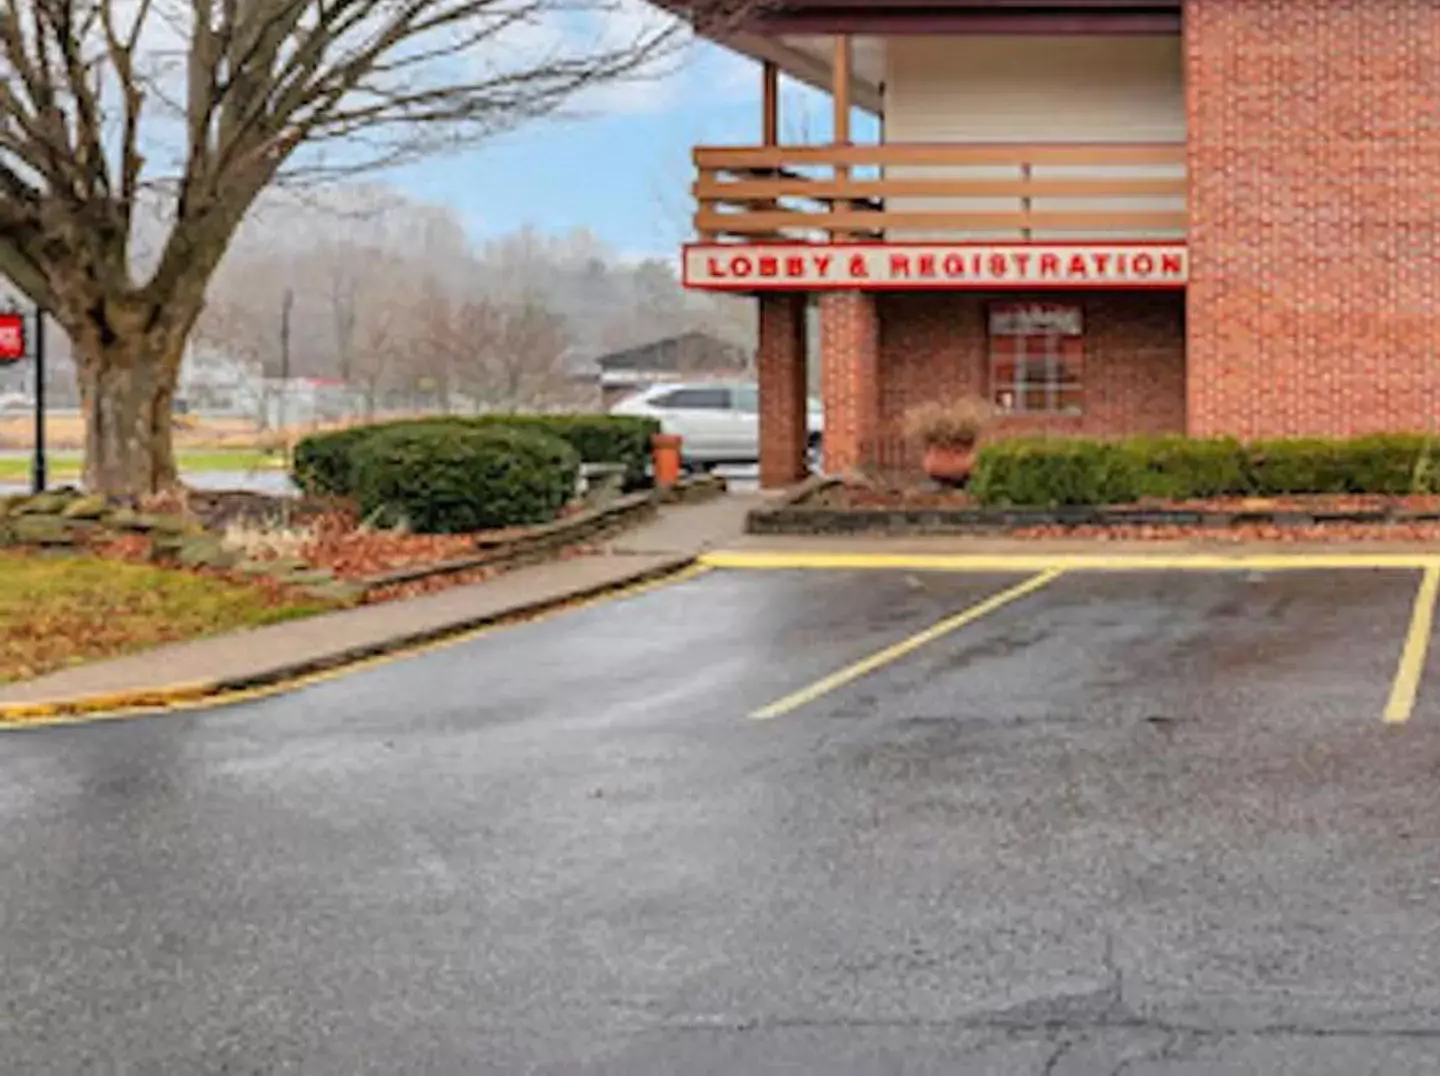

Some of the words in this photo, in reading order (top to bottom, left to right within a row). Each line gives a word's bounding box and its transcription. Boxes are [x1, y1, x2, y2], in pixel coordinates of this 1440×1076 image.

[708, 256, 832, 278] LOBBY
[848, 255, 869, 278] &
[890, 254, 1183, 277] REGISTRATION
